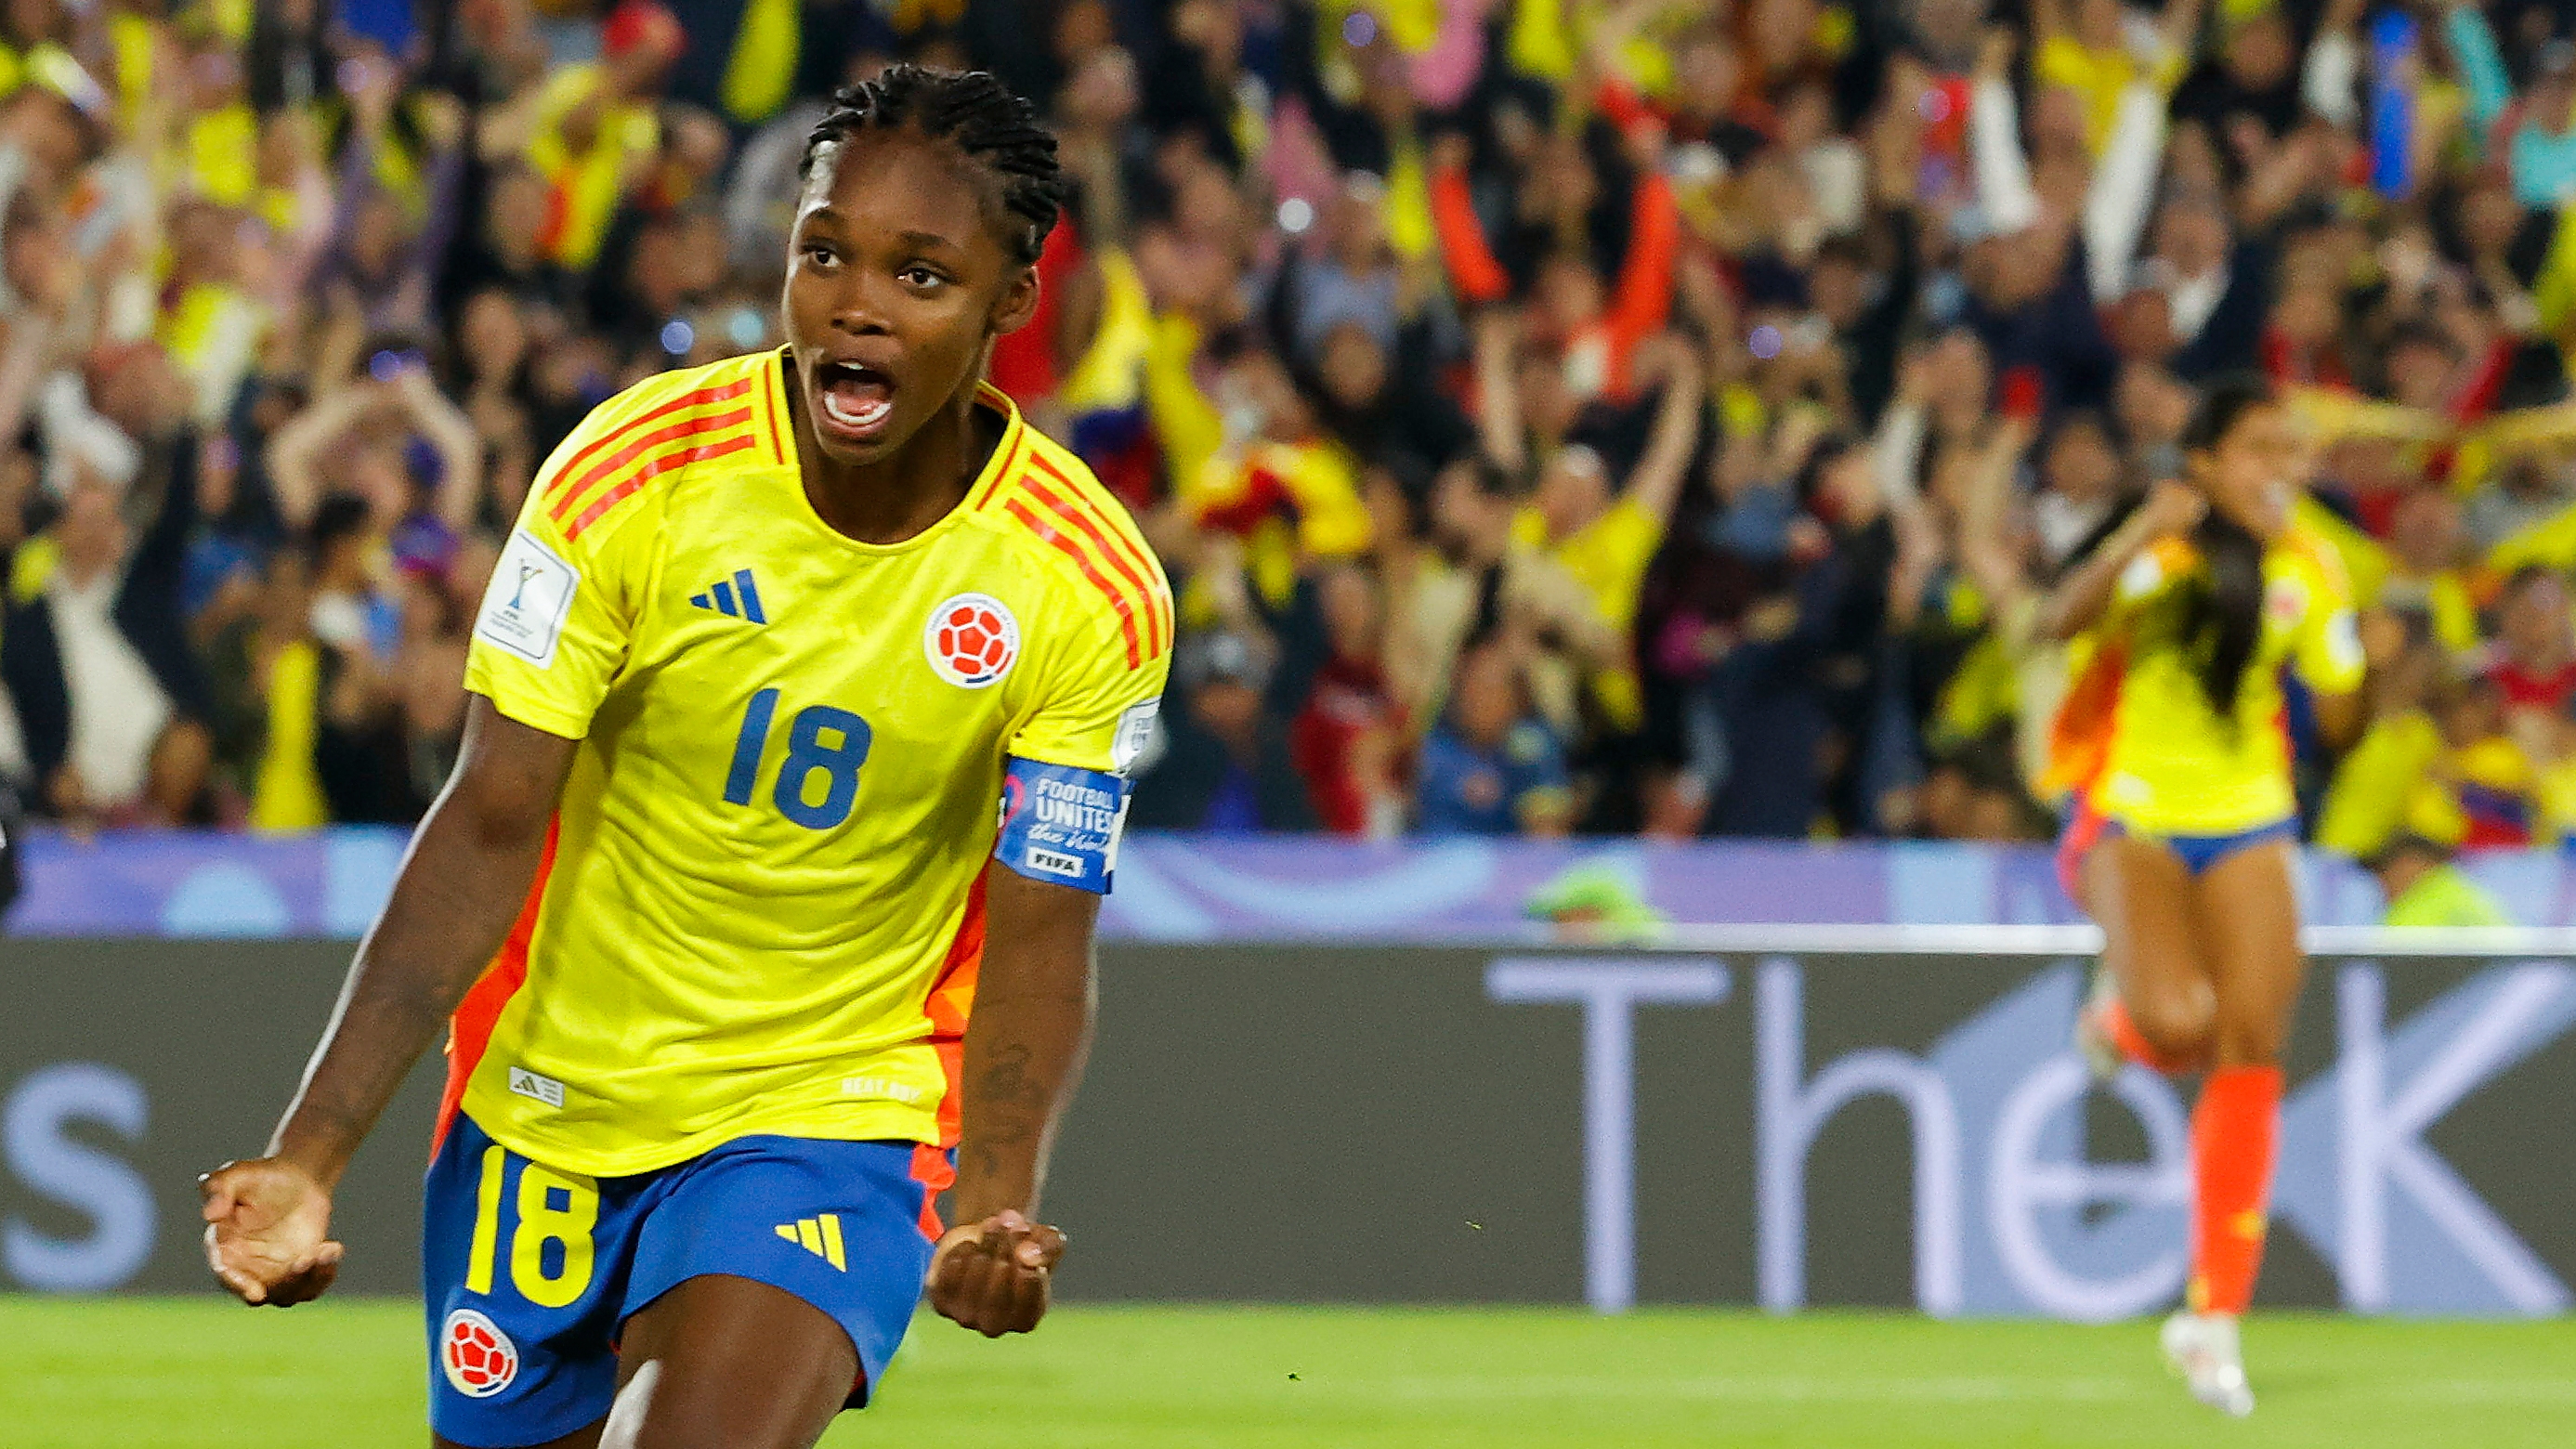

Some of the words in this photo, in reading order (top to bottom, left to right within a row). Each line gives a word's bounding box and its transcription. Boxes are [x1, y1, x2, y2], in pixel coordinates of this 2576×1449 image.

[723, 687, 873, 829] 18
[1035, 854, 1075, 871] FIFA
[1486, 959, 2194, 1317] The
[464, 1144, 599, 1308] 18
